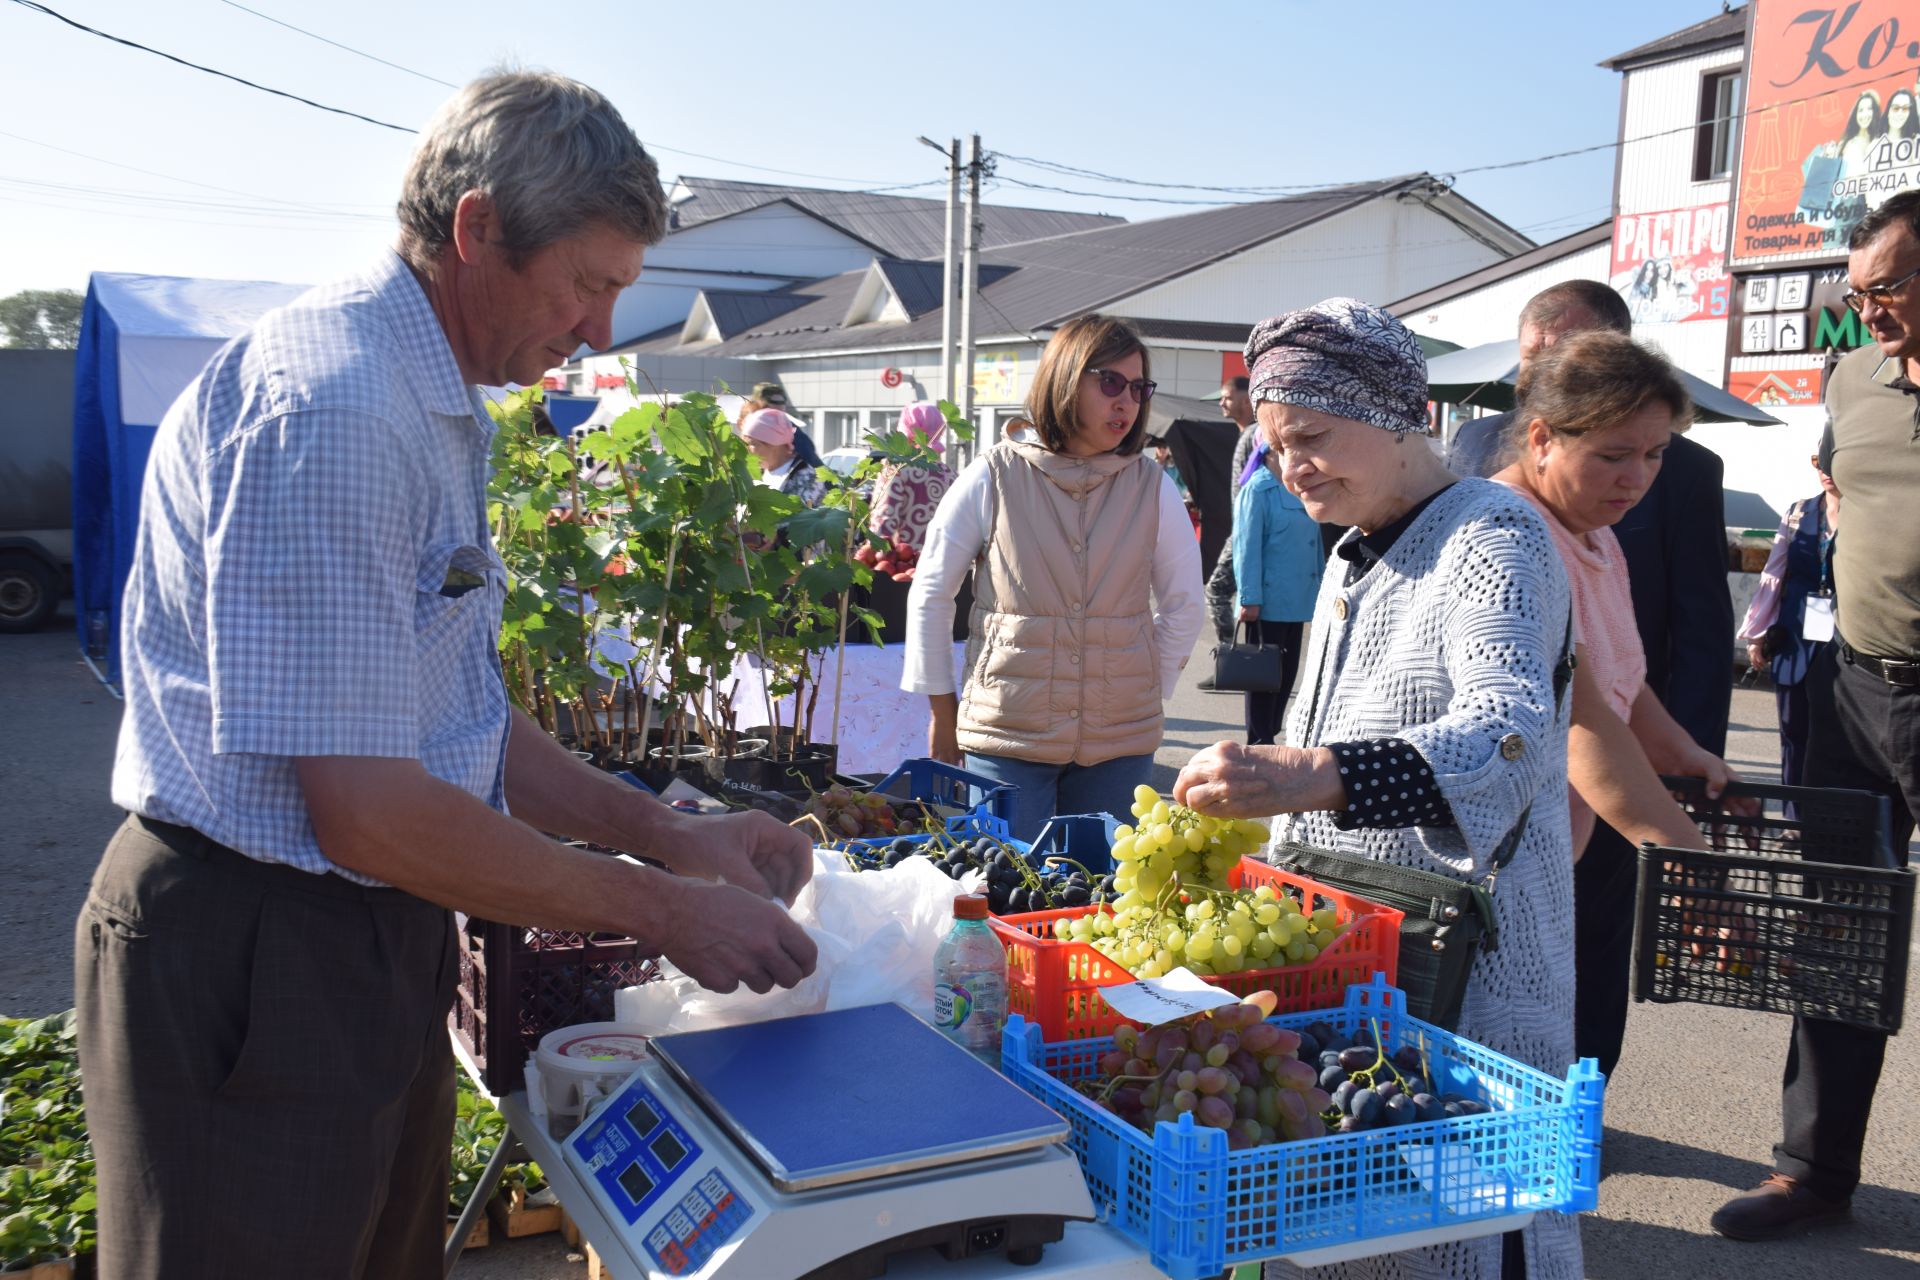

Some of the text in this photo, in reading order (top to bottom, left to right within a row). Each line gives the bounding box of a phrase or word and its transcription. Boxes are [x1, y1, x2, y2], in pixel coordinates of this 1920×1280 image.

[1834, 172, 1909, 196] ОДЕЖДА
[1746, 211, 1805, 231] Одежда
[1809, 209, 1819, 222] и
[1744, 232, 1801, 250] Товары
[1805, 228, 1835, 246] для
[1789, 390, 1813, 400] ЭТАЖ
